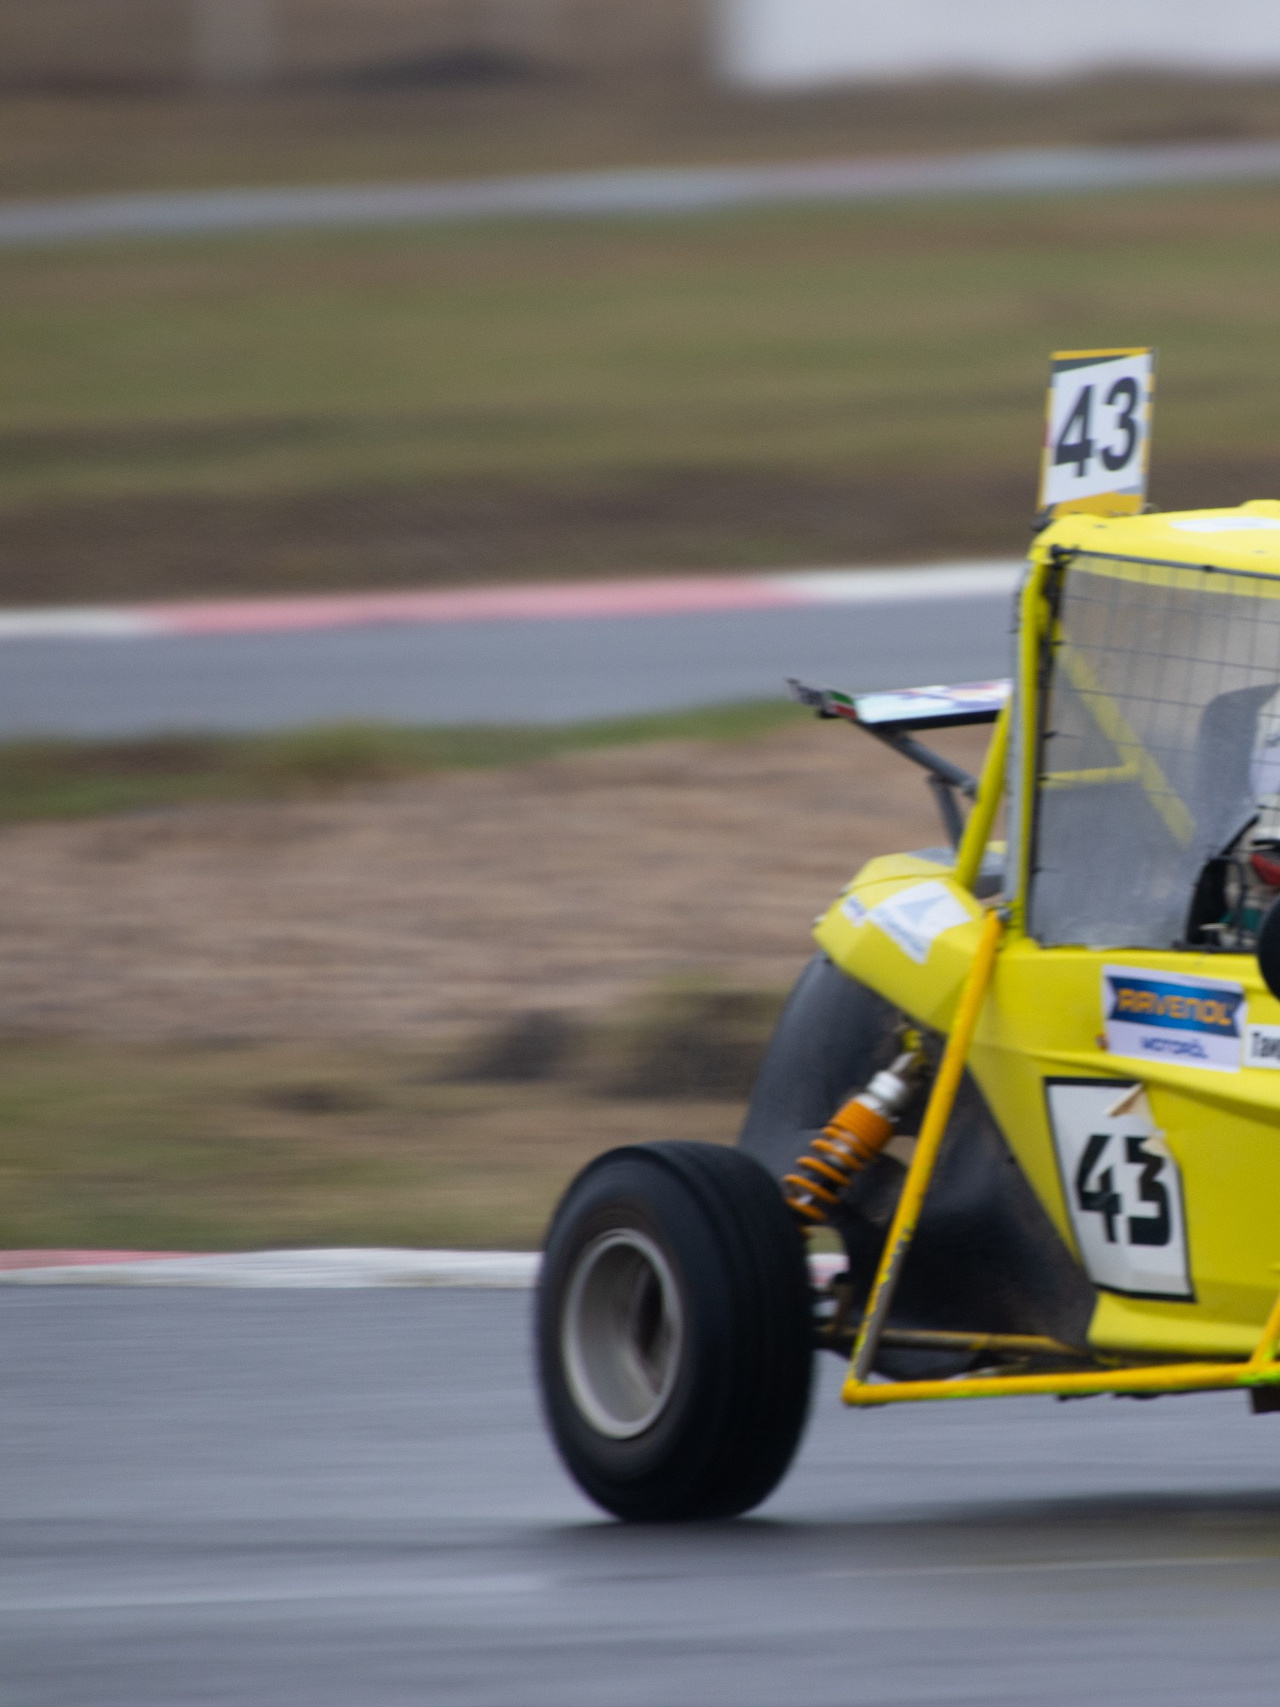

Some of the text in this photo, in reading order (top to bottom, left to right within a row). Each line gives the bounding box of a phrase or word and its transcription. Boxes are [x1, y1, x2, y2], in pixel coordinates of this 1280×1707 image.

[1053, 376, 1139, 477] 43
[1117, 988, 1232, 1026] RAVENOL
[1075, 1133, 1173, 1247] 43
